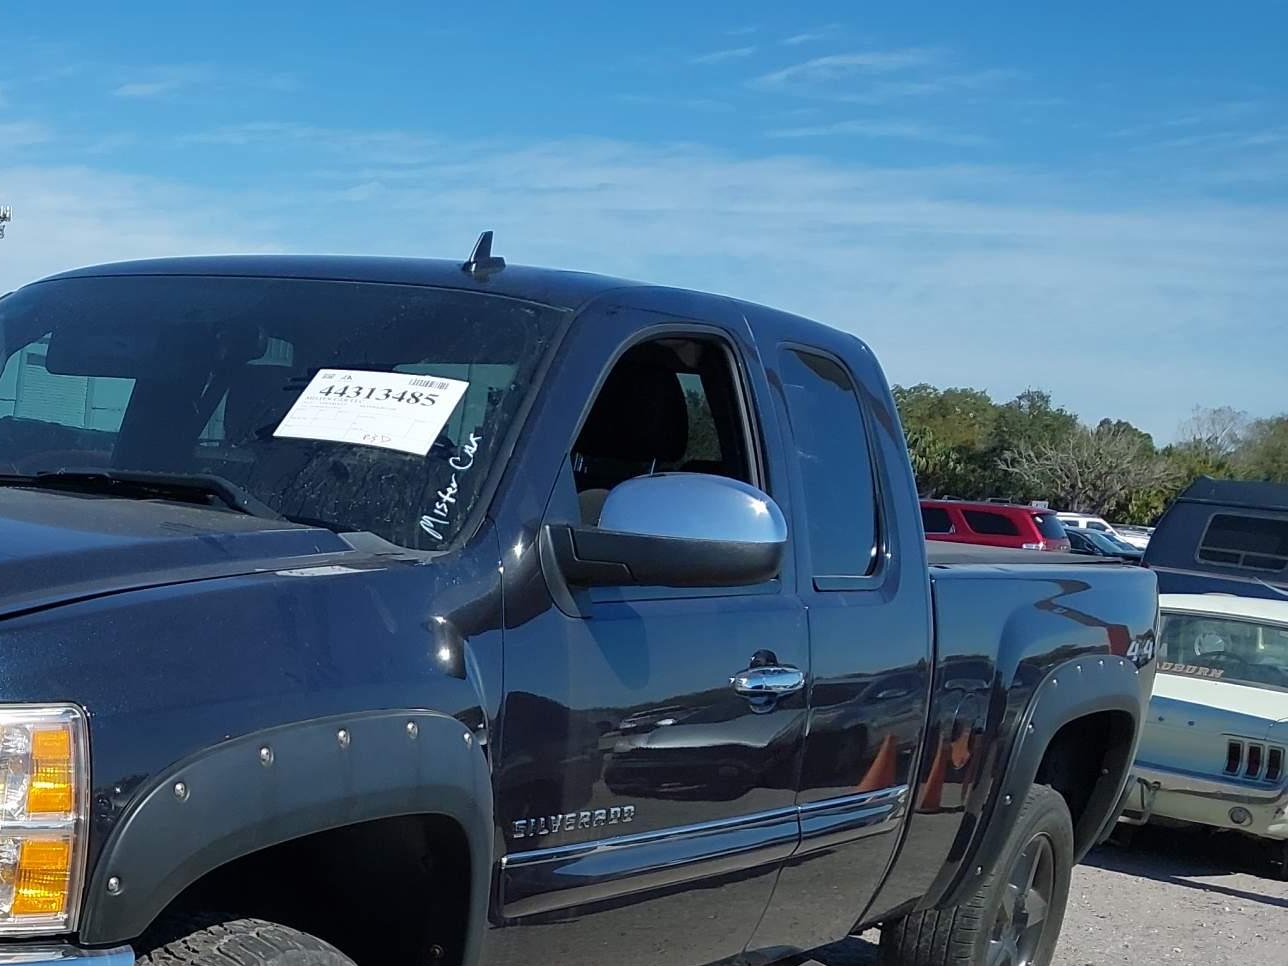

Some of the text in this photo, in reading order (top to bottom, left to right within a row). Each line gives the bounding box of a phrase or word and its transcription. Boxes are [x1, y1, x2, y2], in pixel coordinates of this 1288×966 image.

[319, 384, 440, 408] 44313485
[449, 433, 482, 470] Car
[512, 805, 636, 838] SILVERADO
